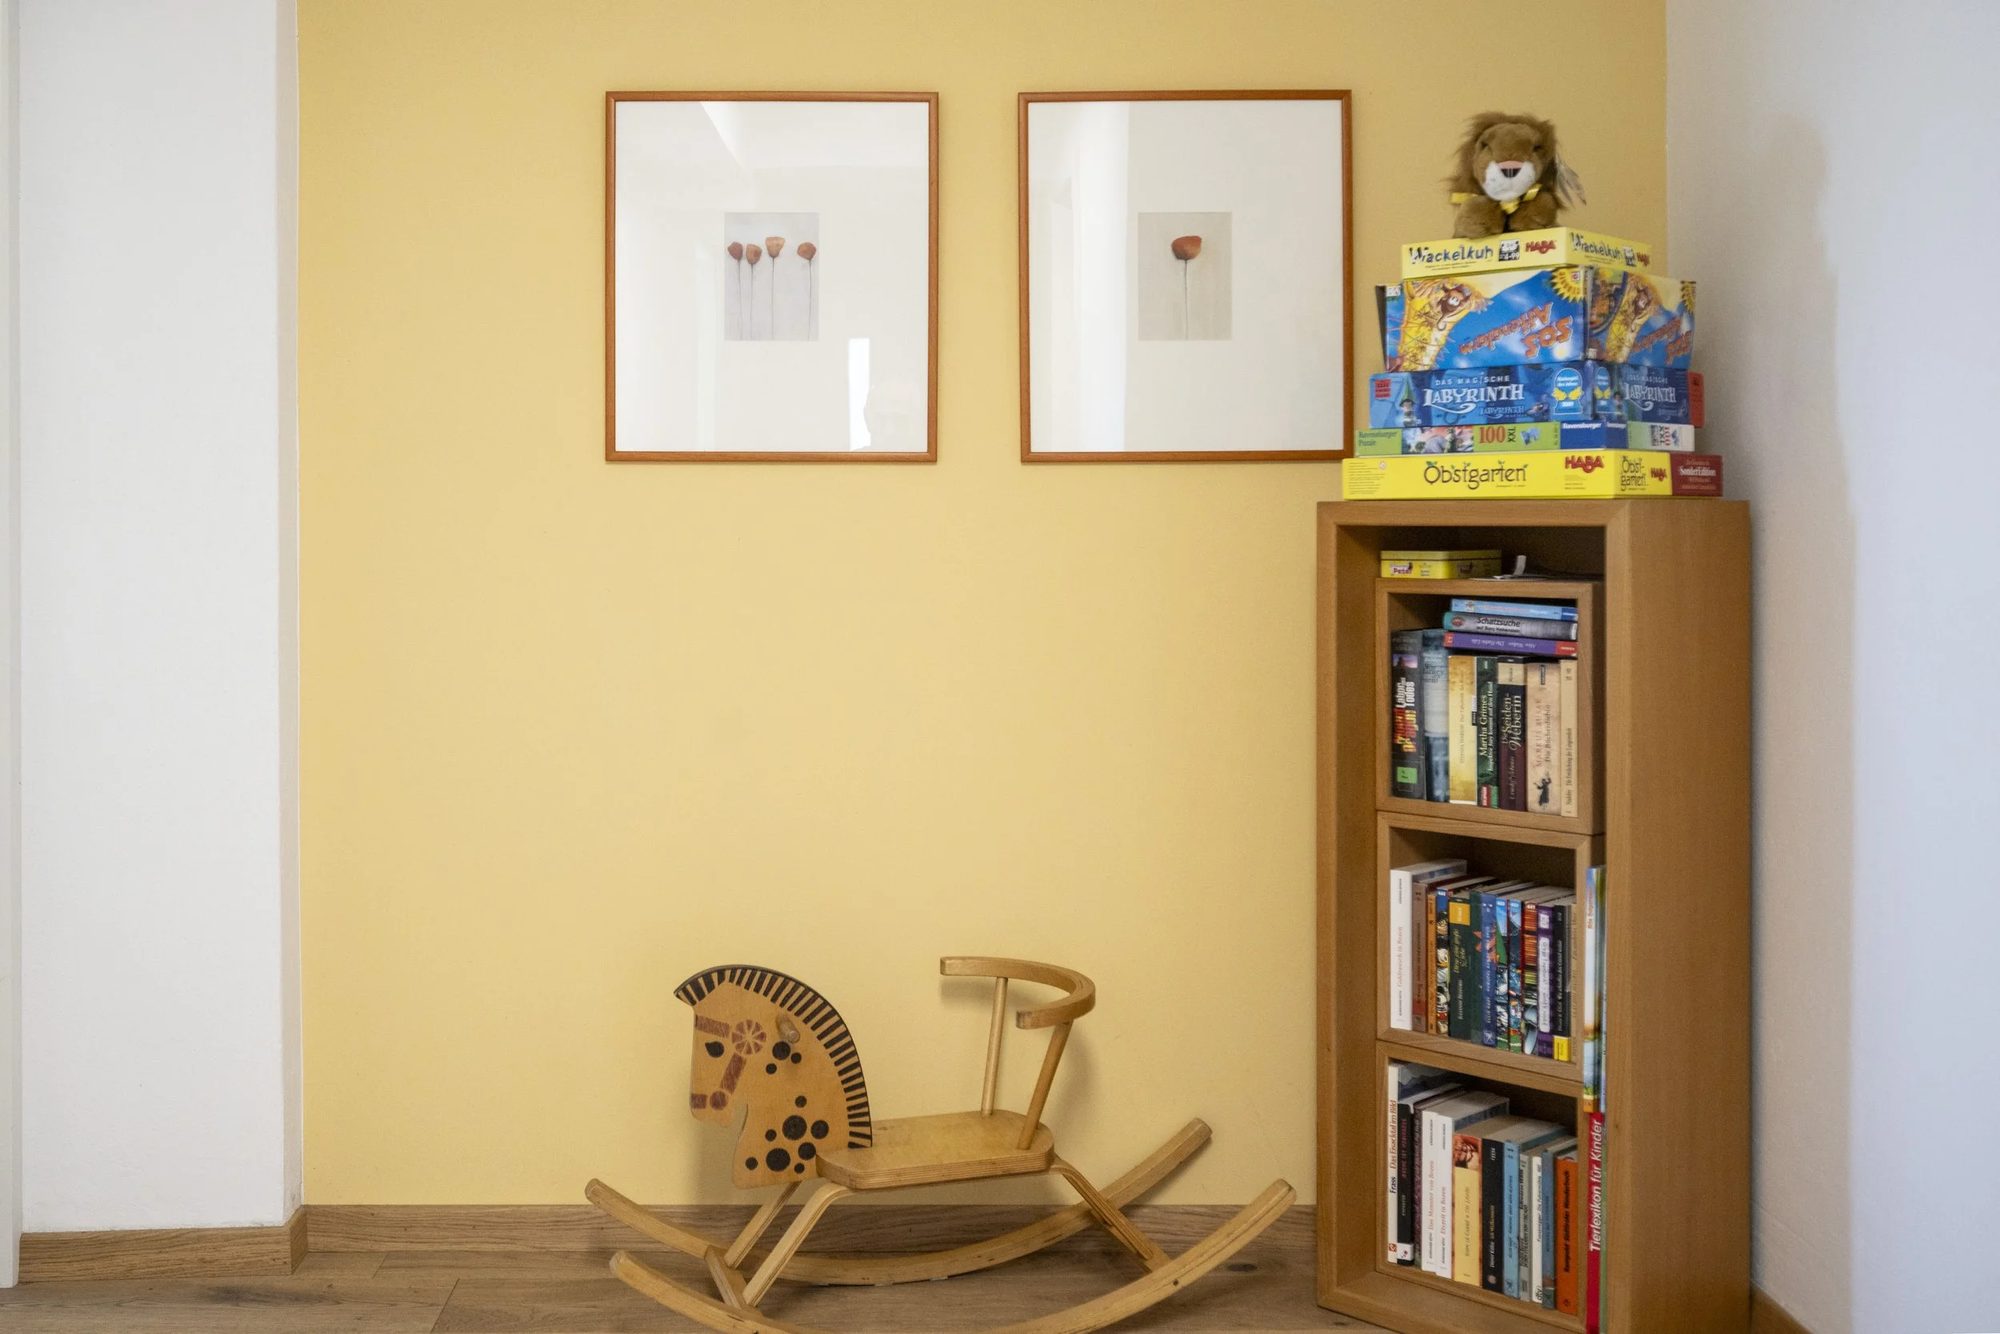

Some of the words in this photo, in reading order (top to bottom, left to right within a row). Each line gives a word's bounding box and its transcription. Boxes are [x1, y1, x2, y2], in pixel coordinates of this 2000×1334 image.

[1409, 244, 1493, 264] Wackelkuh
[1525, 240, 1557, 254] HABA
[1521, 315, 1573, 359] SOS
[1435, 378, 1452, 386] DAS
[1457, 372, 1510, 385] MAGISCHE
[1423, 383, 1525, 414] LABYRINTH
[1624, 382, 1677, 411] LABYRINTH
[1479, 426, 1506, 443] 100
[1507, 427, 1516, 442] XXL
[1424, 463, 1527, 490] Obstgarten
[1565, 455, 1604, 473] HABA
[1476, 616, 1521, 628] Schatzsuche
[1396, 683, 1406, 708] Labor
[1404, 682, 1415, 707] Todes
[1479, 695, 1488, 725] Grimes
[1501, 693, 1512, 733] Seiden-
[1509, 695, 1522, 751] Weberin
[1479, 727, 1488, 756] Martha
[1590, 1120, 1603, 1162] Kinder
[1589, 1167, 1602, 1184] für
[1589, 1186, 1602, 1252] Tierlexikon
